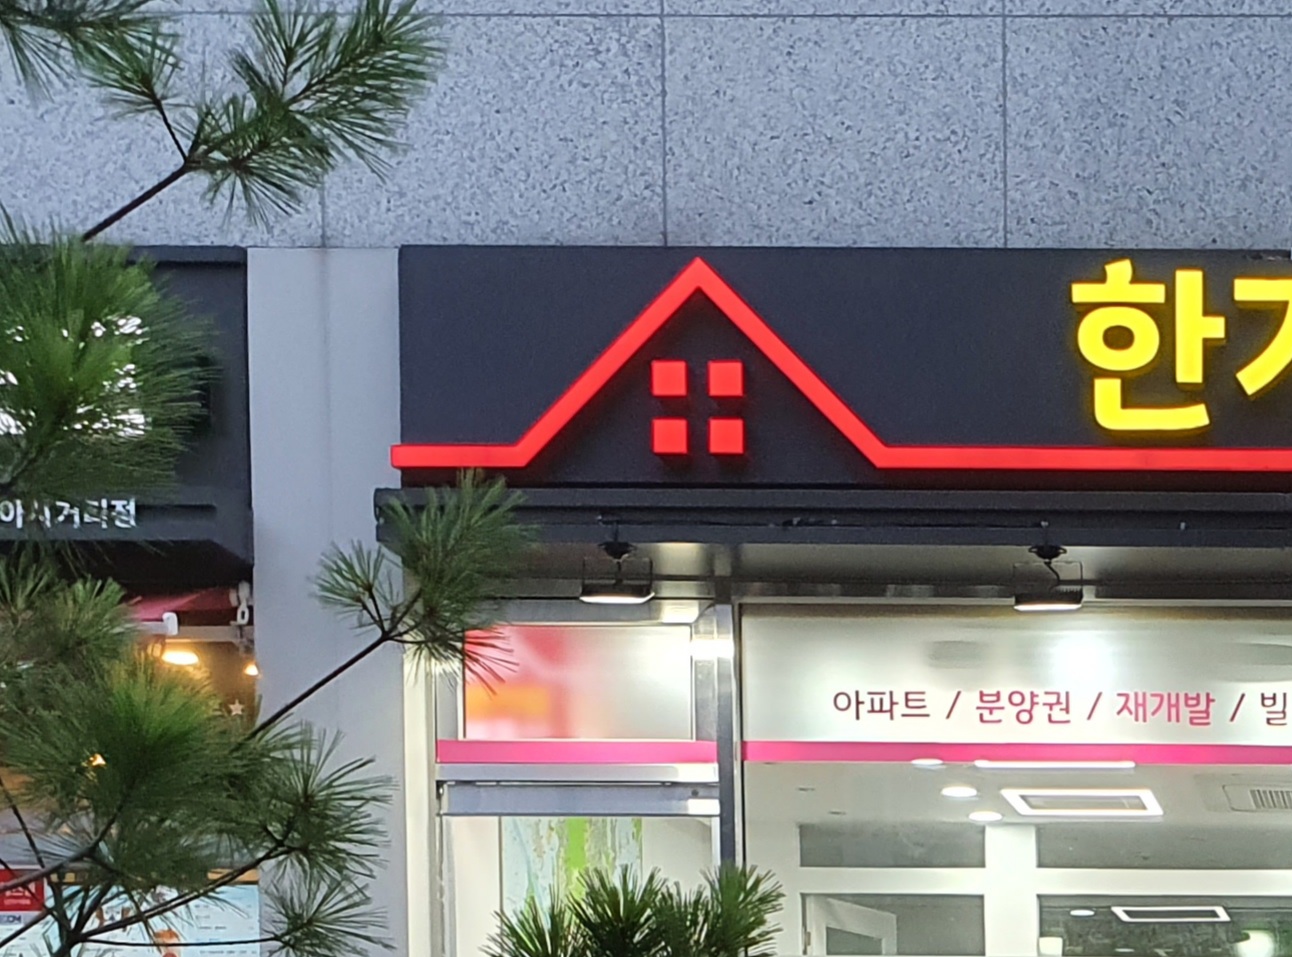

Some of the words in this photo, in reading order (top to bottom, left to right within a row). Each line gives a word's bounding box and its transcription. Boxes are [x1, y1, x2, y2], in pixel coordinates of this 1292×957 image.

[833, 690, 930, 721] 아파트
[976, 690, 1071, 725] 분양권
[1115, 692, 1216, 726] 재개발
